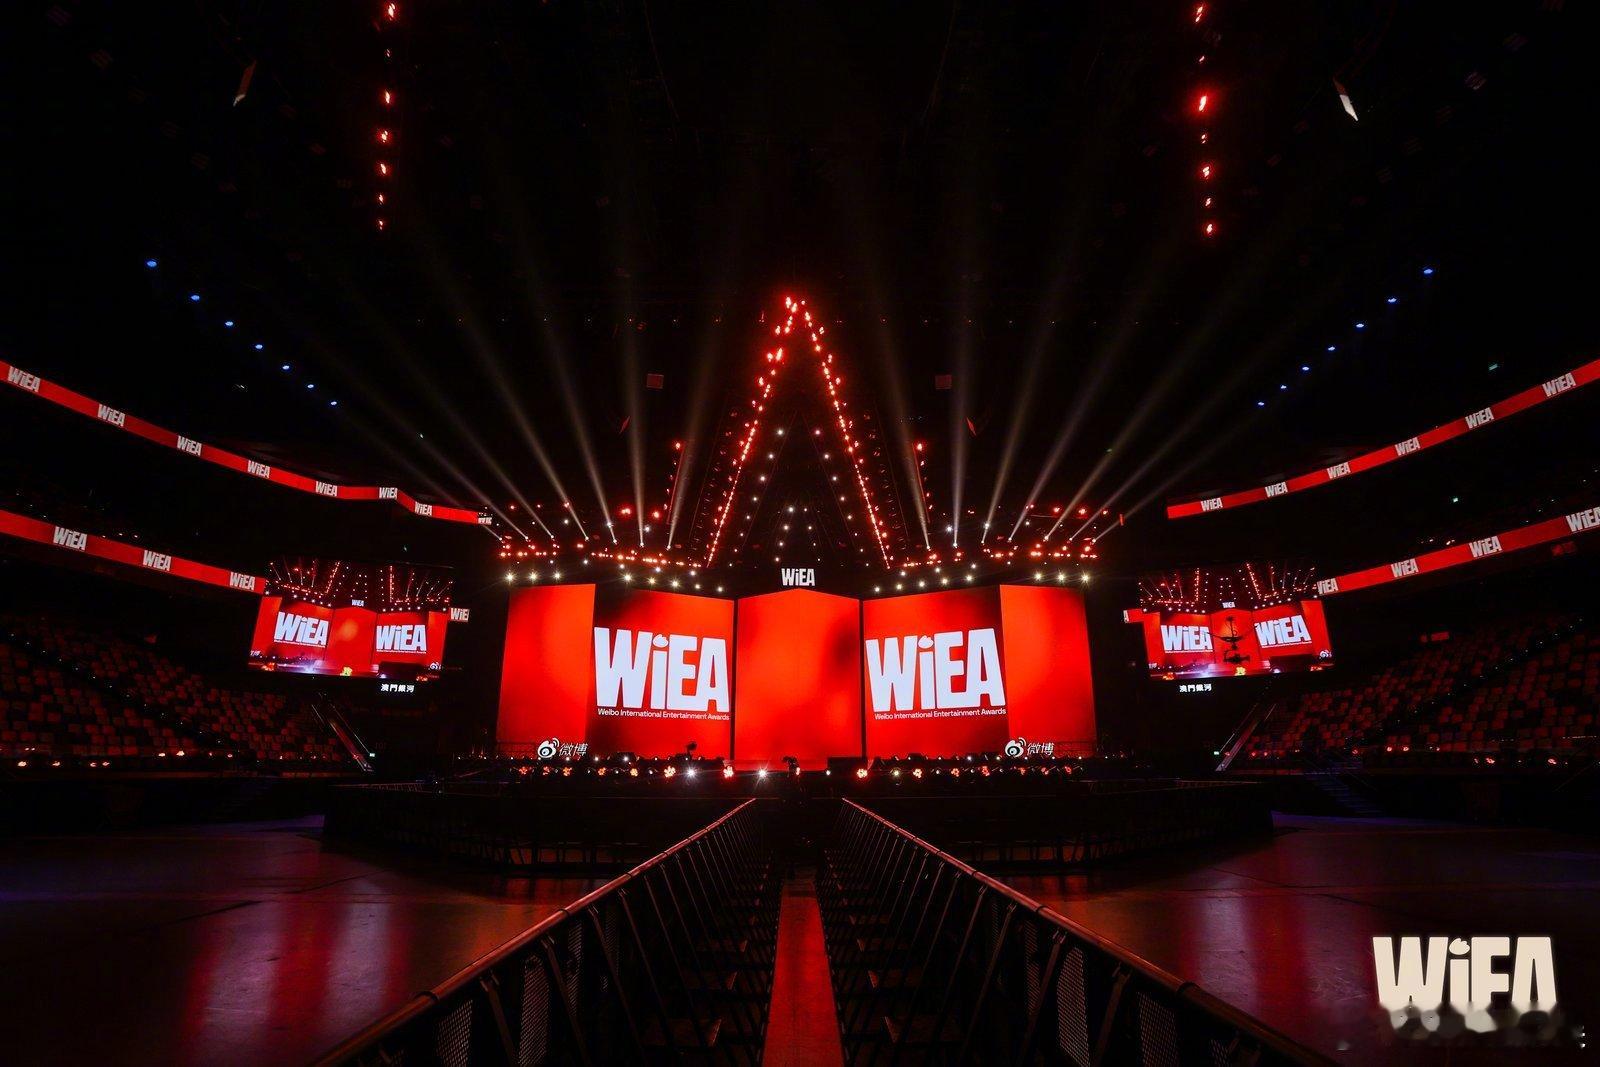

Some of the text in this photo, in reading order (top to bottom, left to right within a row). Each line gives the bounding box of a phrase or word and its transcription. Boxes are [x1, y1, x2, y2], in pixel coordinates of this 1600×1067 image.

[8, 366, 41, 392] WiEA
[1542, 372, 1577, 397] WiEA
[98, 403, 126, 427] WiEA
[1465, 407, 1494, 429] WiEA
[177, 435, 202, 456] WiEA
[1395, 437, 1421, 456] WiEA
[247, 460, 271, 479] WiEA
[1327, 461, 1351, 479] WiEA
[316, 480, 338, 497] WiEA
[1265, 481, 1289, 498] WiEA
[1201, 497, 1223, 512] WiEA
[53, 526, 88, 551] WiEA
[1469, 535, 1502, 558] WiEA
[143, 550, 172, 572] WiEA
[1391, 558, 1419, 578] WiEA
[229, 572, 256, 591] WiEA
[782, 568, 815, 586] WiEA
[273, 611, 329, 646] WiEA
[376, 624, 427, 651] WiEA
[1161, 624, 1213, 651] WiEA
[1254, 614, 1312, 647] WiEA
[594, 626, 730, 713] WiEA
[865, 627, 1006, 712] WiEA
[597, 708, 730, 721] Weibo International Entertainment Awards
[894, 711, 932, 719] International
[933, 709, 980, 718] Entertainment
[981, 707, 1006, 715] Awards
[558, 743, 589, 759] 微博
[1026, 742, 1055, 757] 微博
